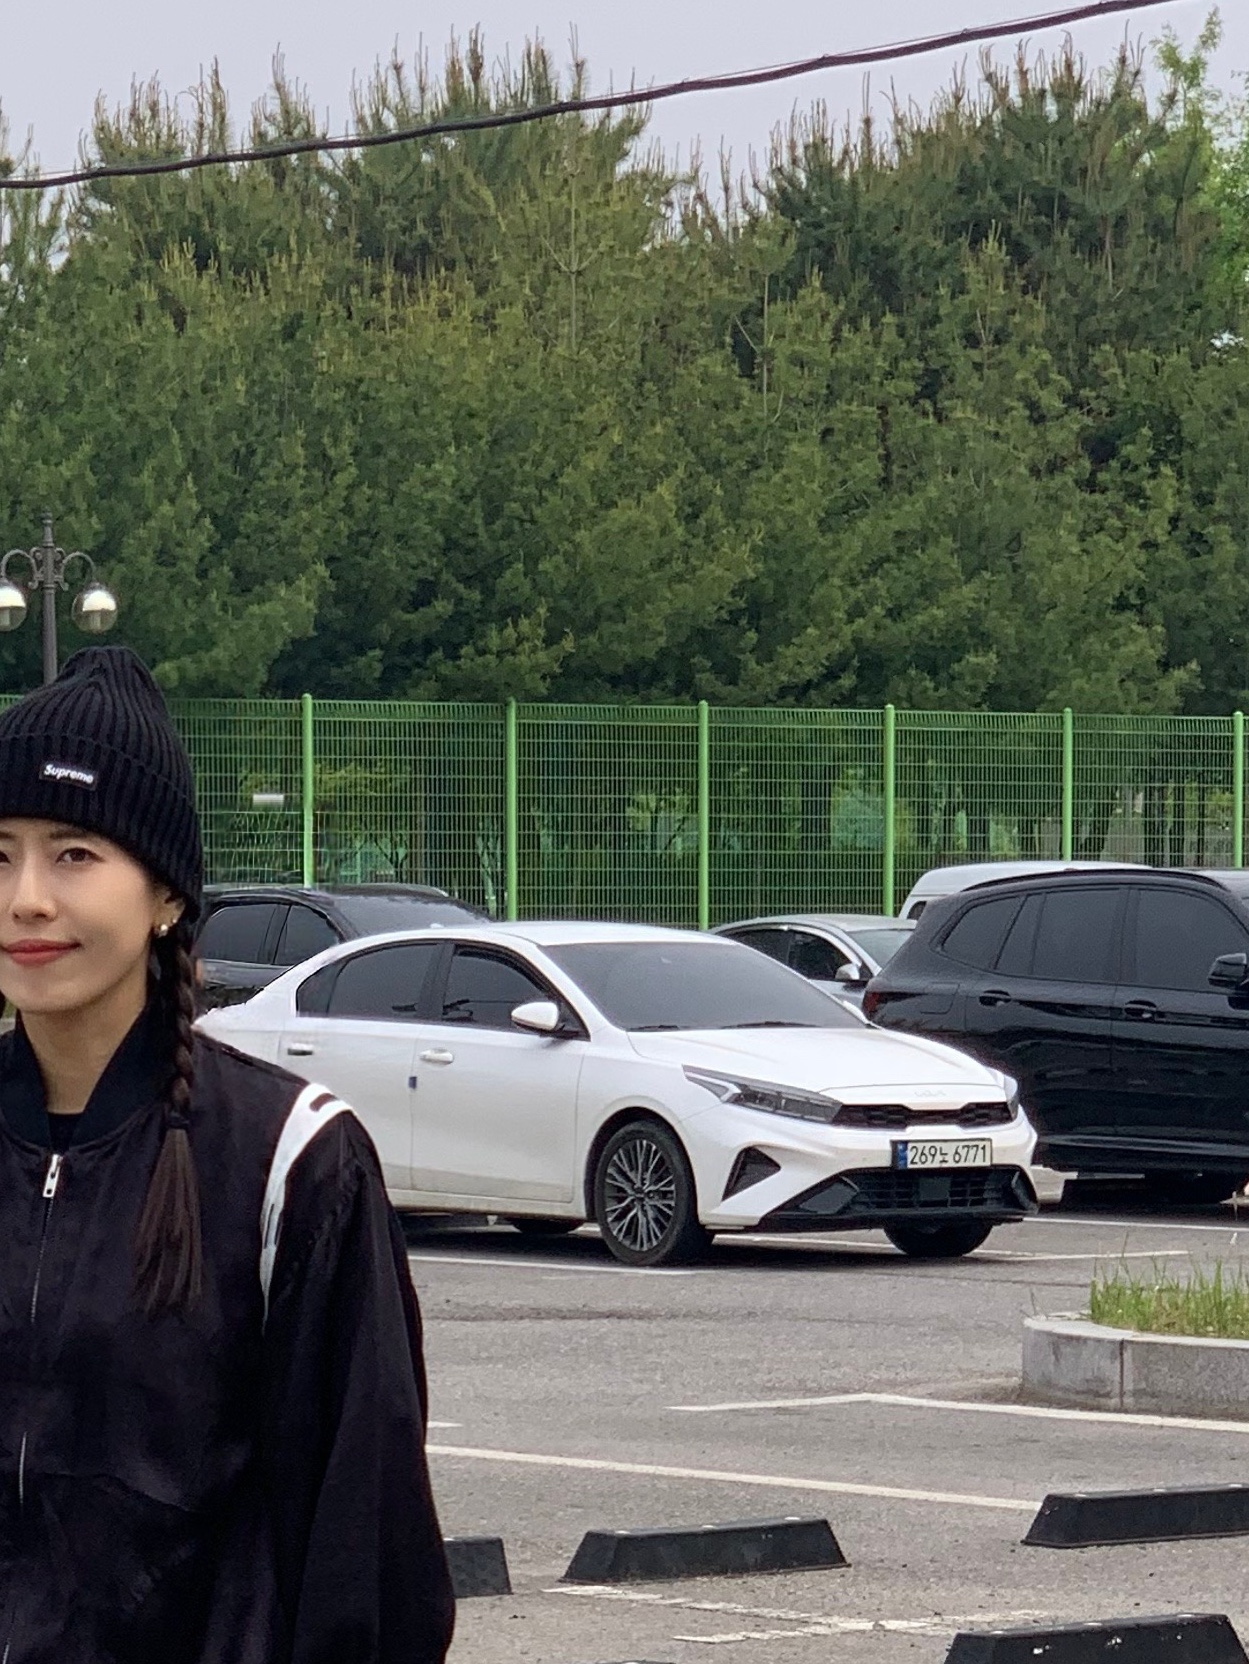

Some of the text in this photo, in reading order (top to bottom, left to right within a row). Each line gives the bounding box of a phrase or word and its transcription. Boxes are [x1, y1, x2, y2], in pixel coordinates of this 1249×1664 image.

[43, 763, 94, 784] Supreme
[909, 1144, 987, 1165] 269노 6771
